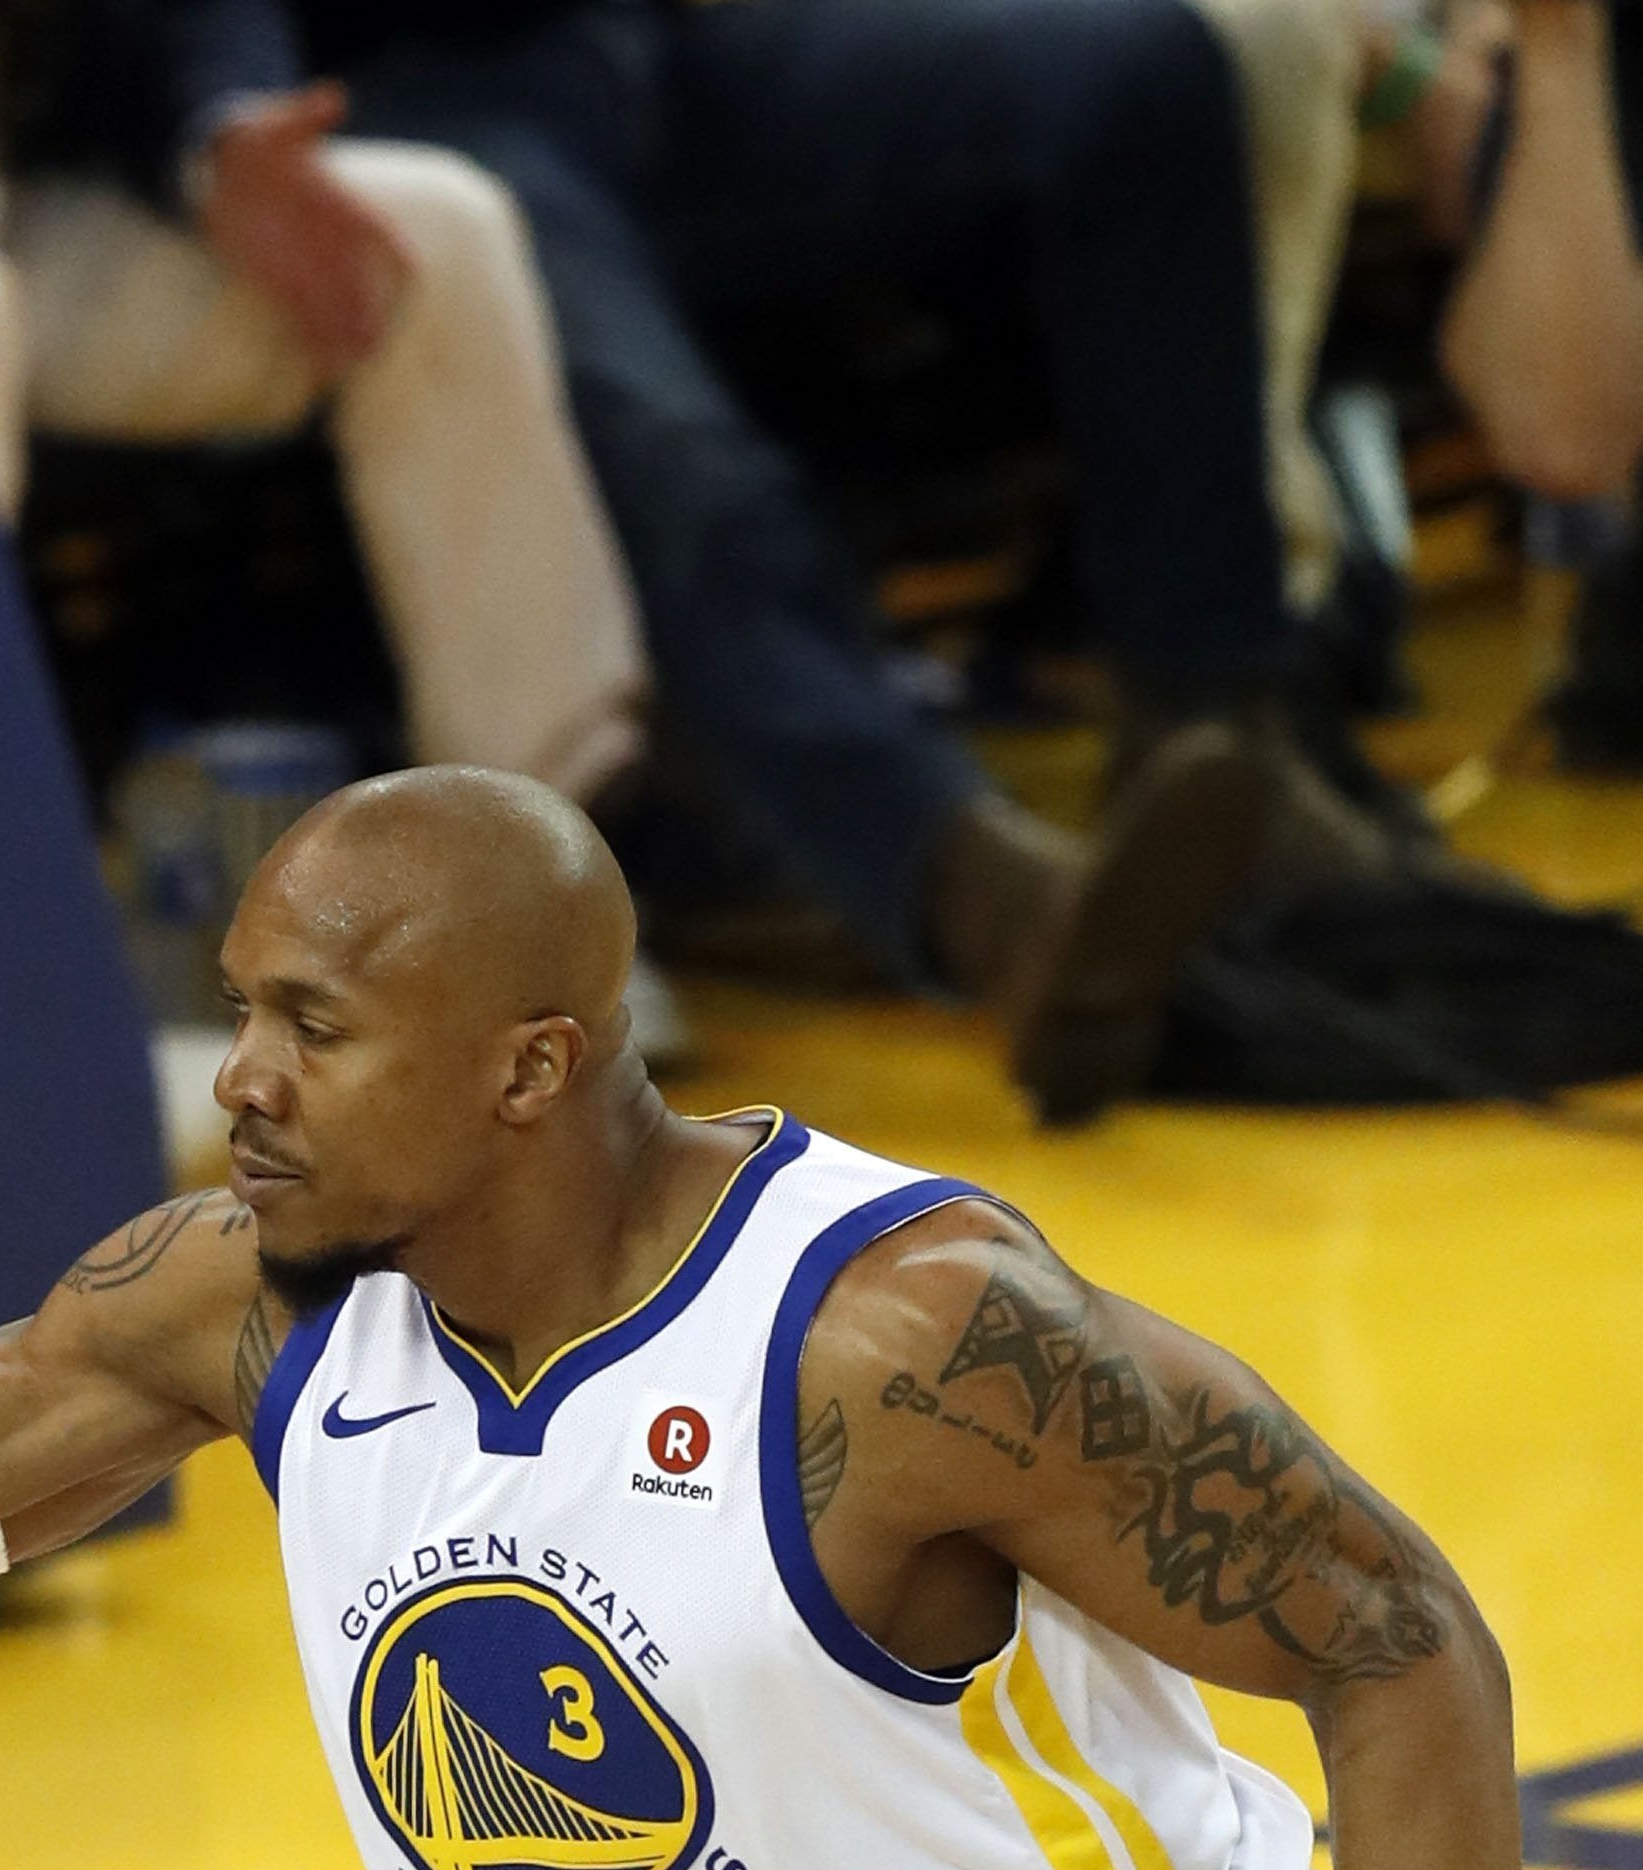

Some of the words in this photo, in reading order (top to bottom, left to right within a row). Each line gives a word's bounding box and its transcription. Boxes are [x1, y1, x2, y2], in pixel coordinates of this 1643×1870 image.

[663, 1418, 694, 1464] R
[631, 1473, 713, 1502] Rakuten
[339, 1532, 518, 1642] GOLDEN
[541, 1548, 670, 1681] STATE
[539, 1665, 606, 1762] 3
